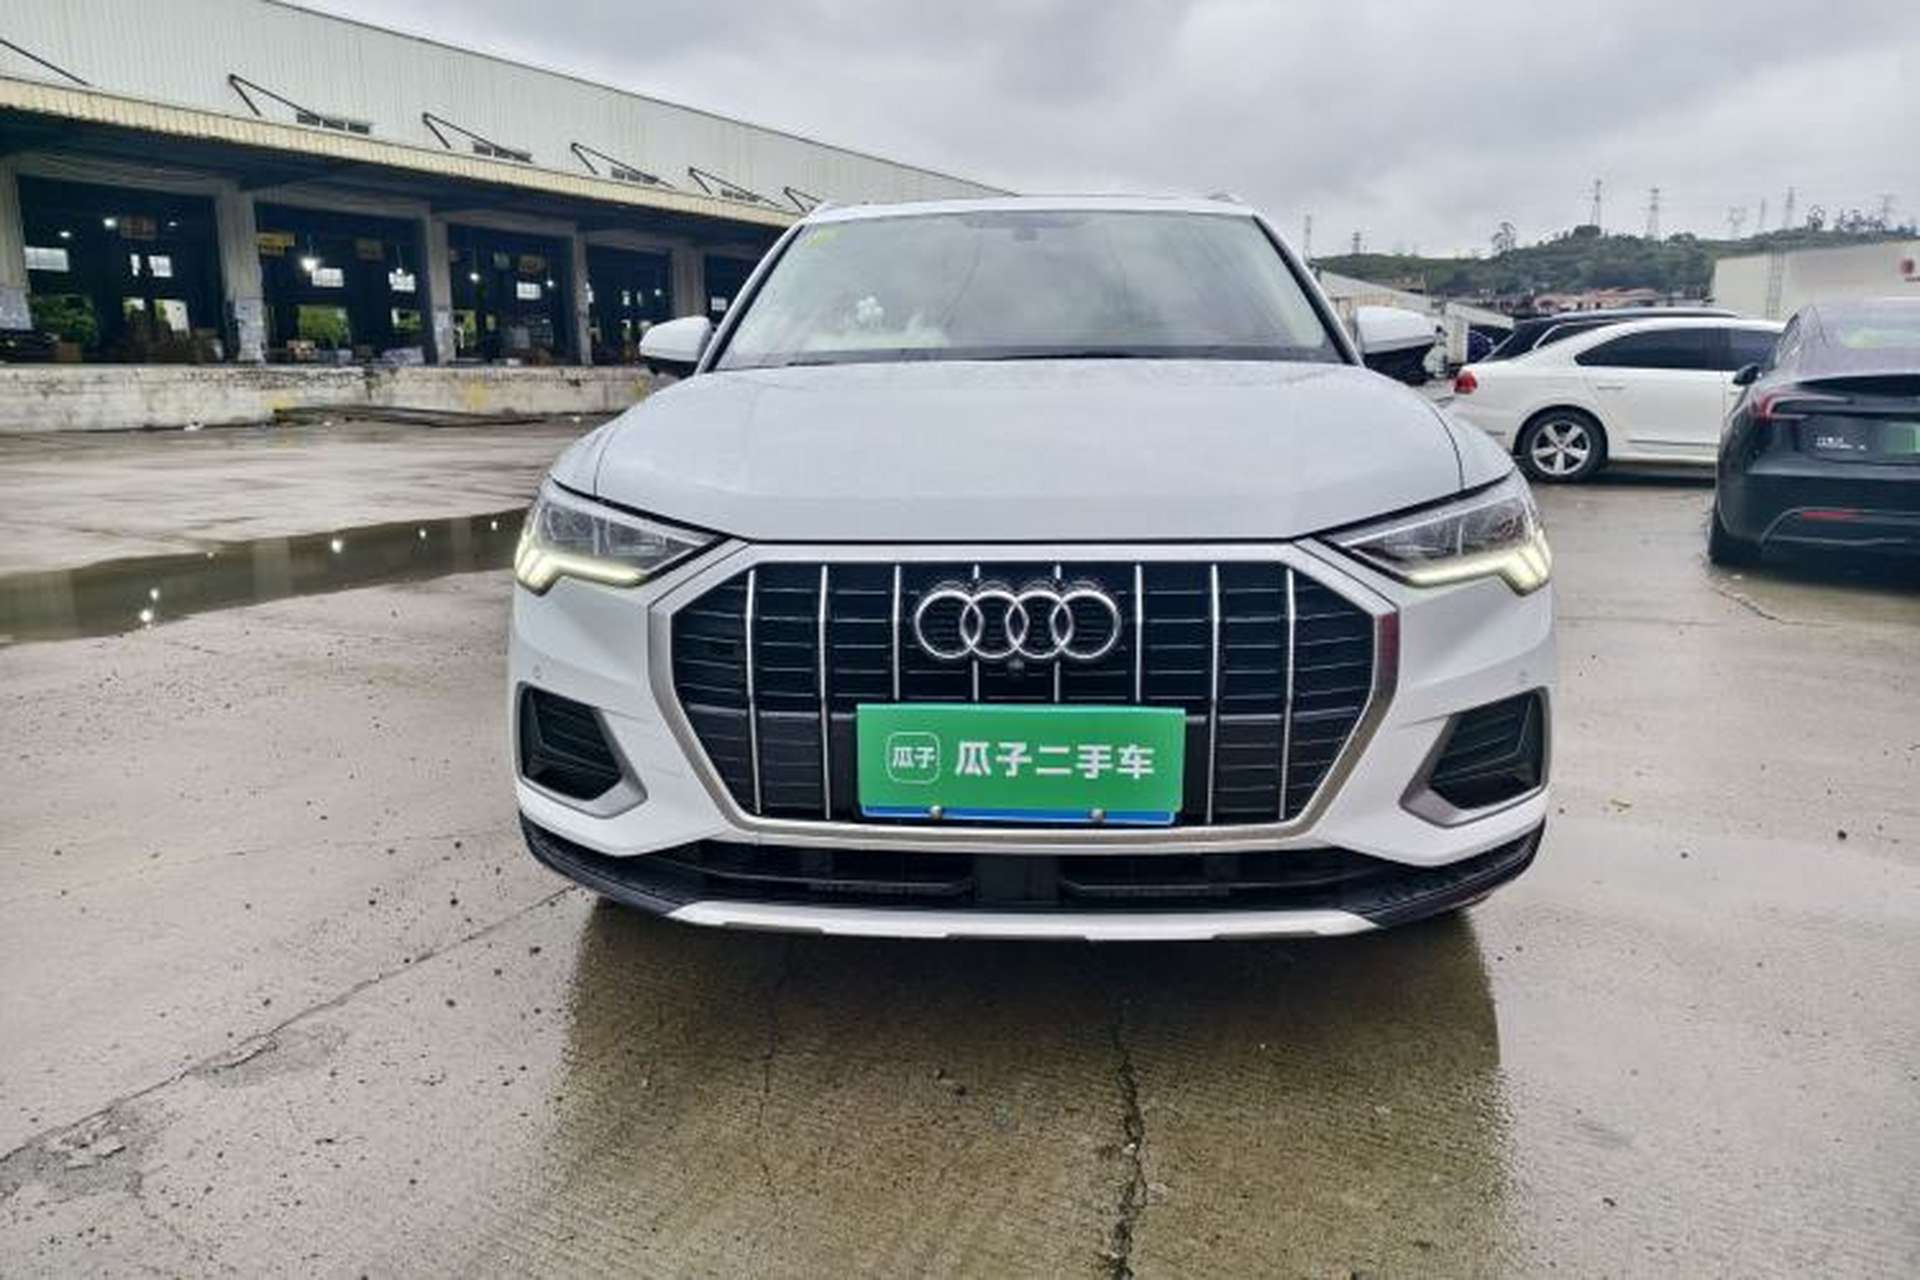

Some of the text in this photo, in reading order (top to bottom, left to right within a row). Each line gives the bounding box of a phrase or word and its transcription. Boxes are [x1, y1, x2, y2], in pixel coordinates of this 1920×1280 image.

[893, 746, 936, 768] 瓜子
[956, 741, 1155, 779] 瓜子二手车
